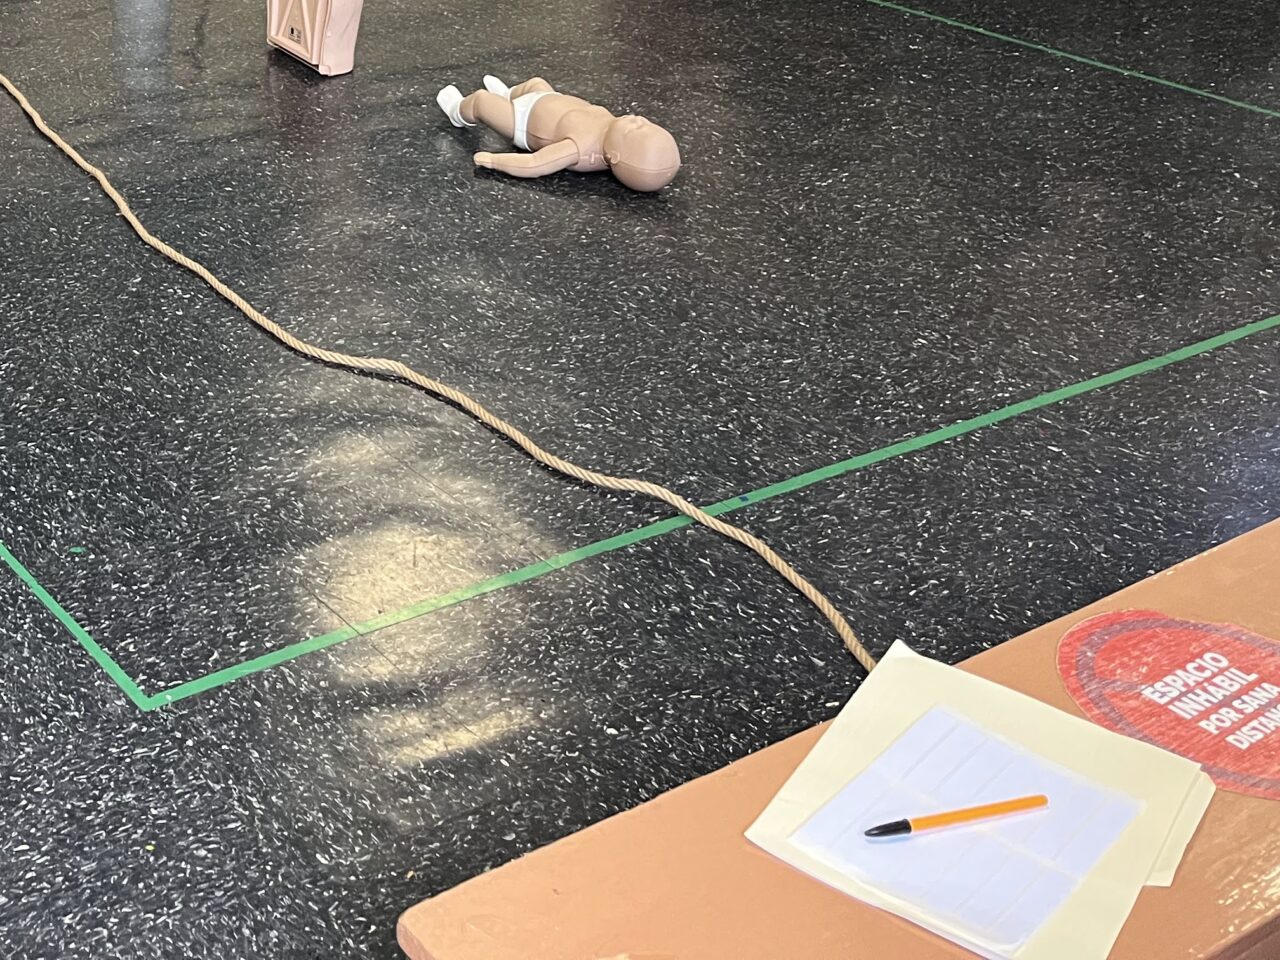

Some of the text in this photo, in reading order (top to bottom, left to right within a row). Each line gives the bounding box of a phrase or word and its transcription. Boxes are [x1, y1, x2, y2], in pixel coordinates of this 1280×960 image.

[1141, 652, 1229, 704] ESPACIO
[1167, 668, 1259, 720] INHÁBIL
[1198, 682, 1280, 735] POR SANA
